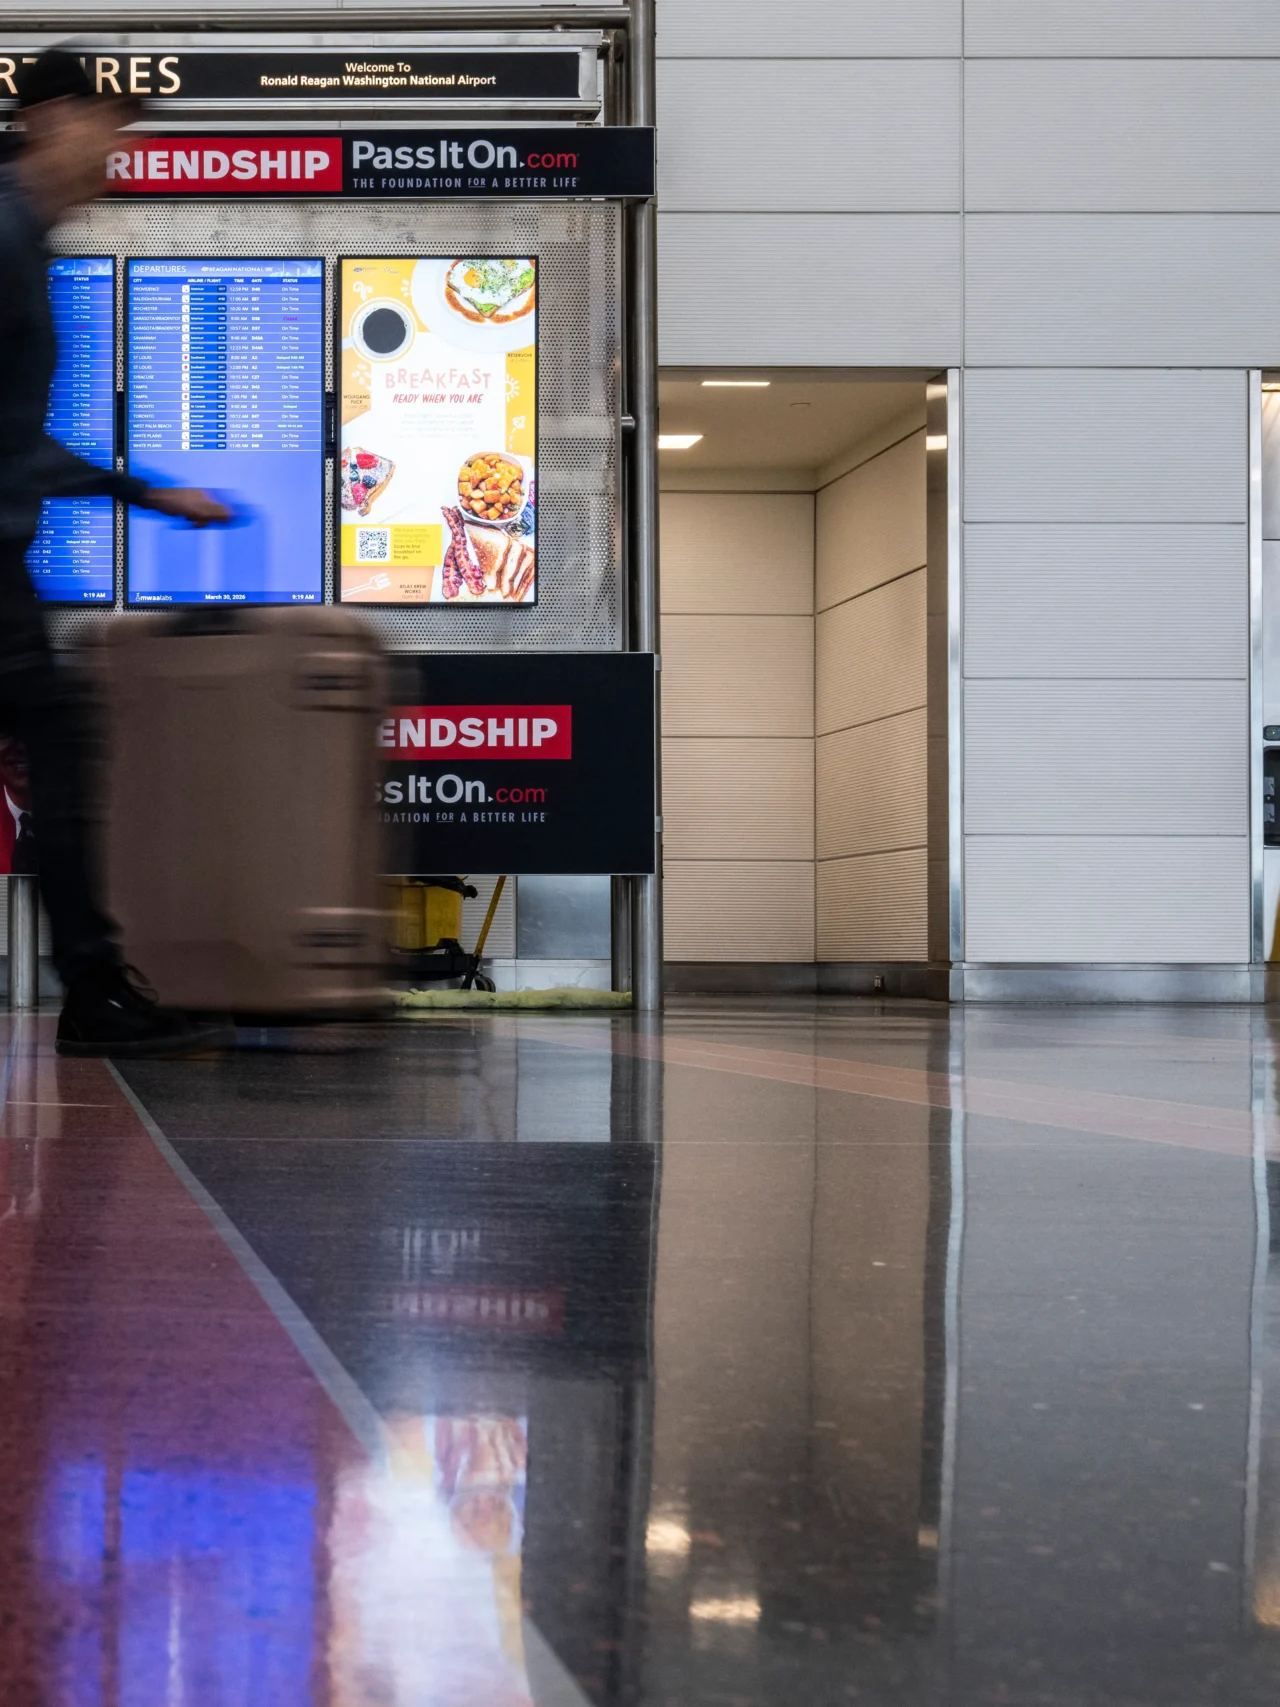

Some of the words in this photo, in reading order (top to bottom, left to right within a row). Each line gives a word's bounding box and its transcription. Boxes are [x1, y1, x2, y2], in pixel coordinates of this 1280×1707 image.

[345, 62, 394, 72] Welcome
[397, 63, 411, 72] To
[261, 75, 298, 85] Ronald
[301, 76, 340, 88] Reagan
[342, 75, 407, 88] Washington
[410, 75, 455, 85] National
[457, 75, 496, 87] Airport
[352, 140, 578, 170] PassItOn.com
[106, 149, 330, 180] RIENDSHIP
[353, 177, 374, 189] THE
[381, 177, 462, 189] FOUNDATION
[468, 177, 486, 189] FOR
[491, 177, 500, 188] A
[505, 177, 548, 188] BETTER
[553, 177, 578, 188] LIFE
[386, 368, 491, 389] BREAKFAST
[393, 394, 419, 403] READY
[423, 394, 447, 403] WHEN
[450, 394, 466, 403] YOU
[467, 394, 483, 403] ARE
[376, 718, 557, 747] ENDSHIP
[375, 774, 545, 804] sItOn.com
[383, 813, 430, 823] DATION
[436, 813, 454, 823] FOR
[460, 813, 467, 822] A
[473, 812, 515, 822] BETTER
[521, 813, 545, 822] LIFE
